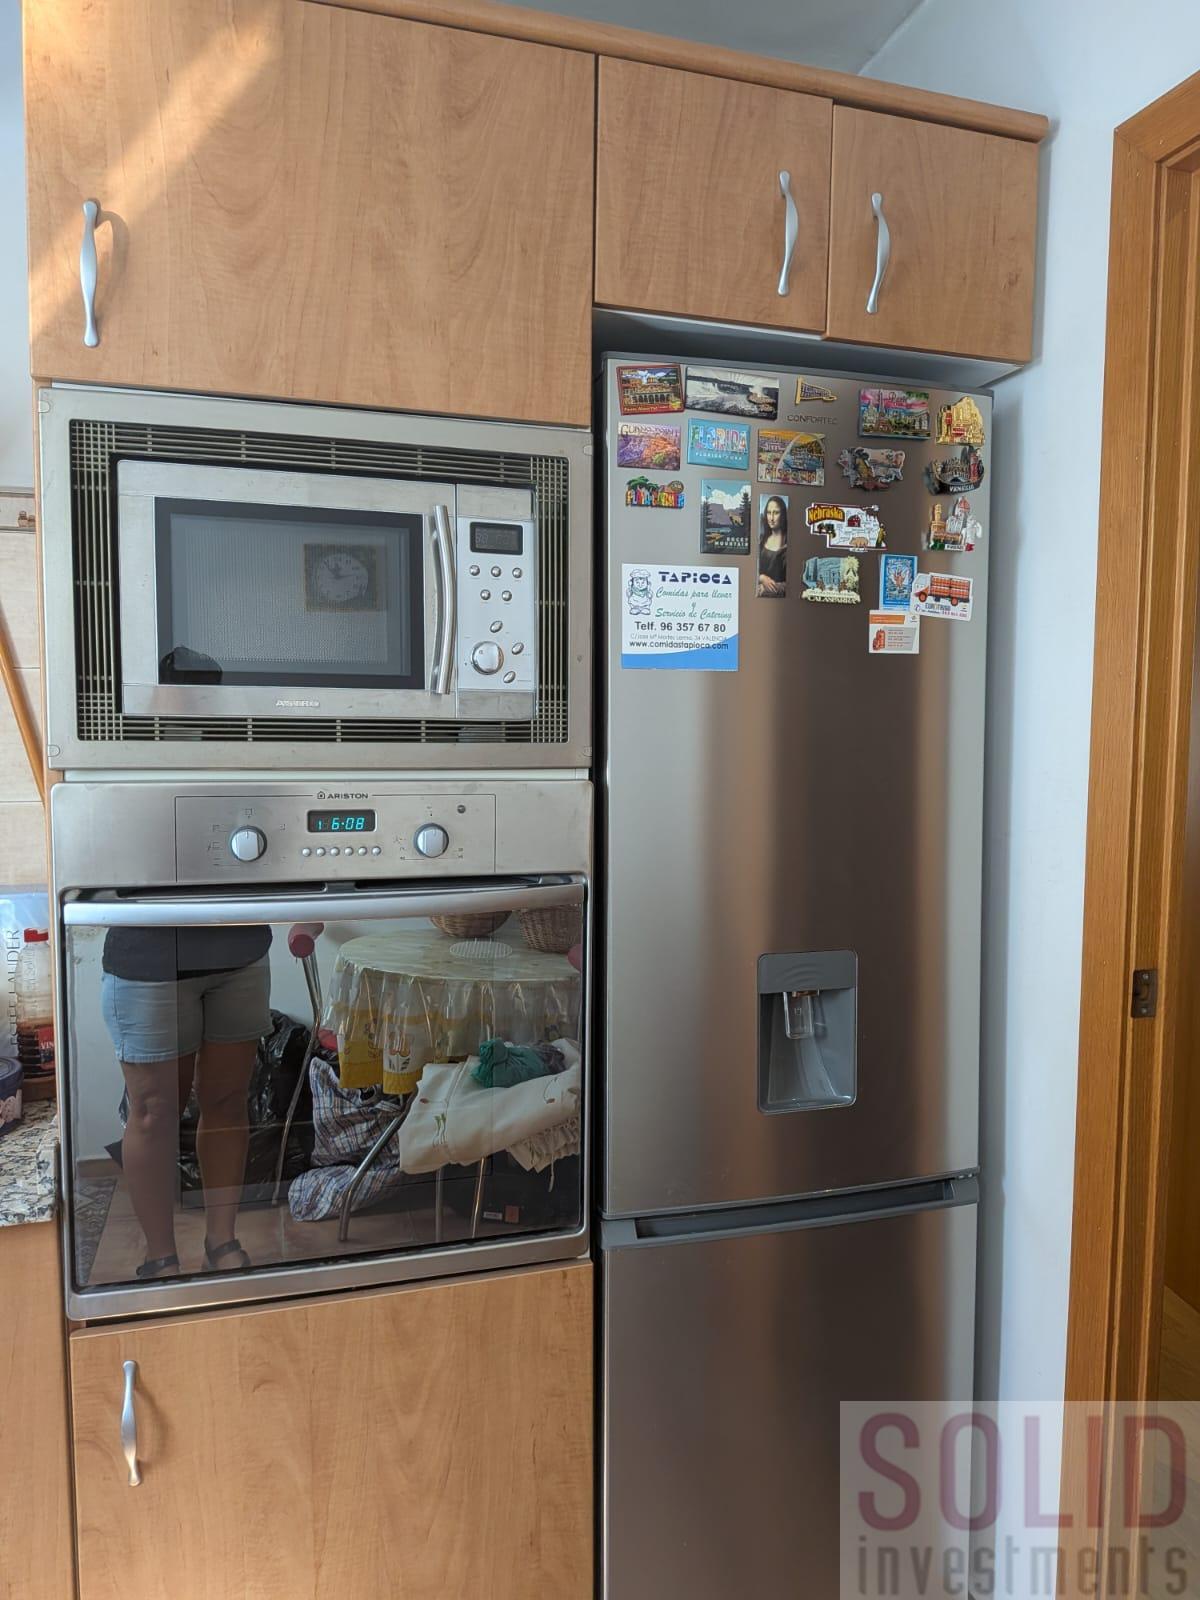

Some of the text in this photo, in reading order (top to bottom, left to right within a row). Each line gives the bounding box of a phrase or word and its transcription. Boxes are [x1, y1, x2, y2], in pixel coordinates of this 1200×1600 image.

[786, 414, 838, 425] CONFORTEC
[691, 425, 747, 451] FLORIDA
[808, 506, 846, 524] Nebraska
[656, 586, 732, 599] Comidas para llevar
[655, 608, 732, 621] Servicio de Catering
[634, 621, 726, 633] Telf. 96 357 67 80
[629, 641, 729, 651] www.comidastapioca.com
[327, 792, 369, 800] ARISTON
